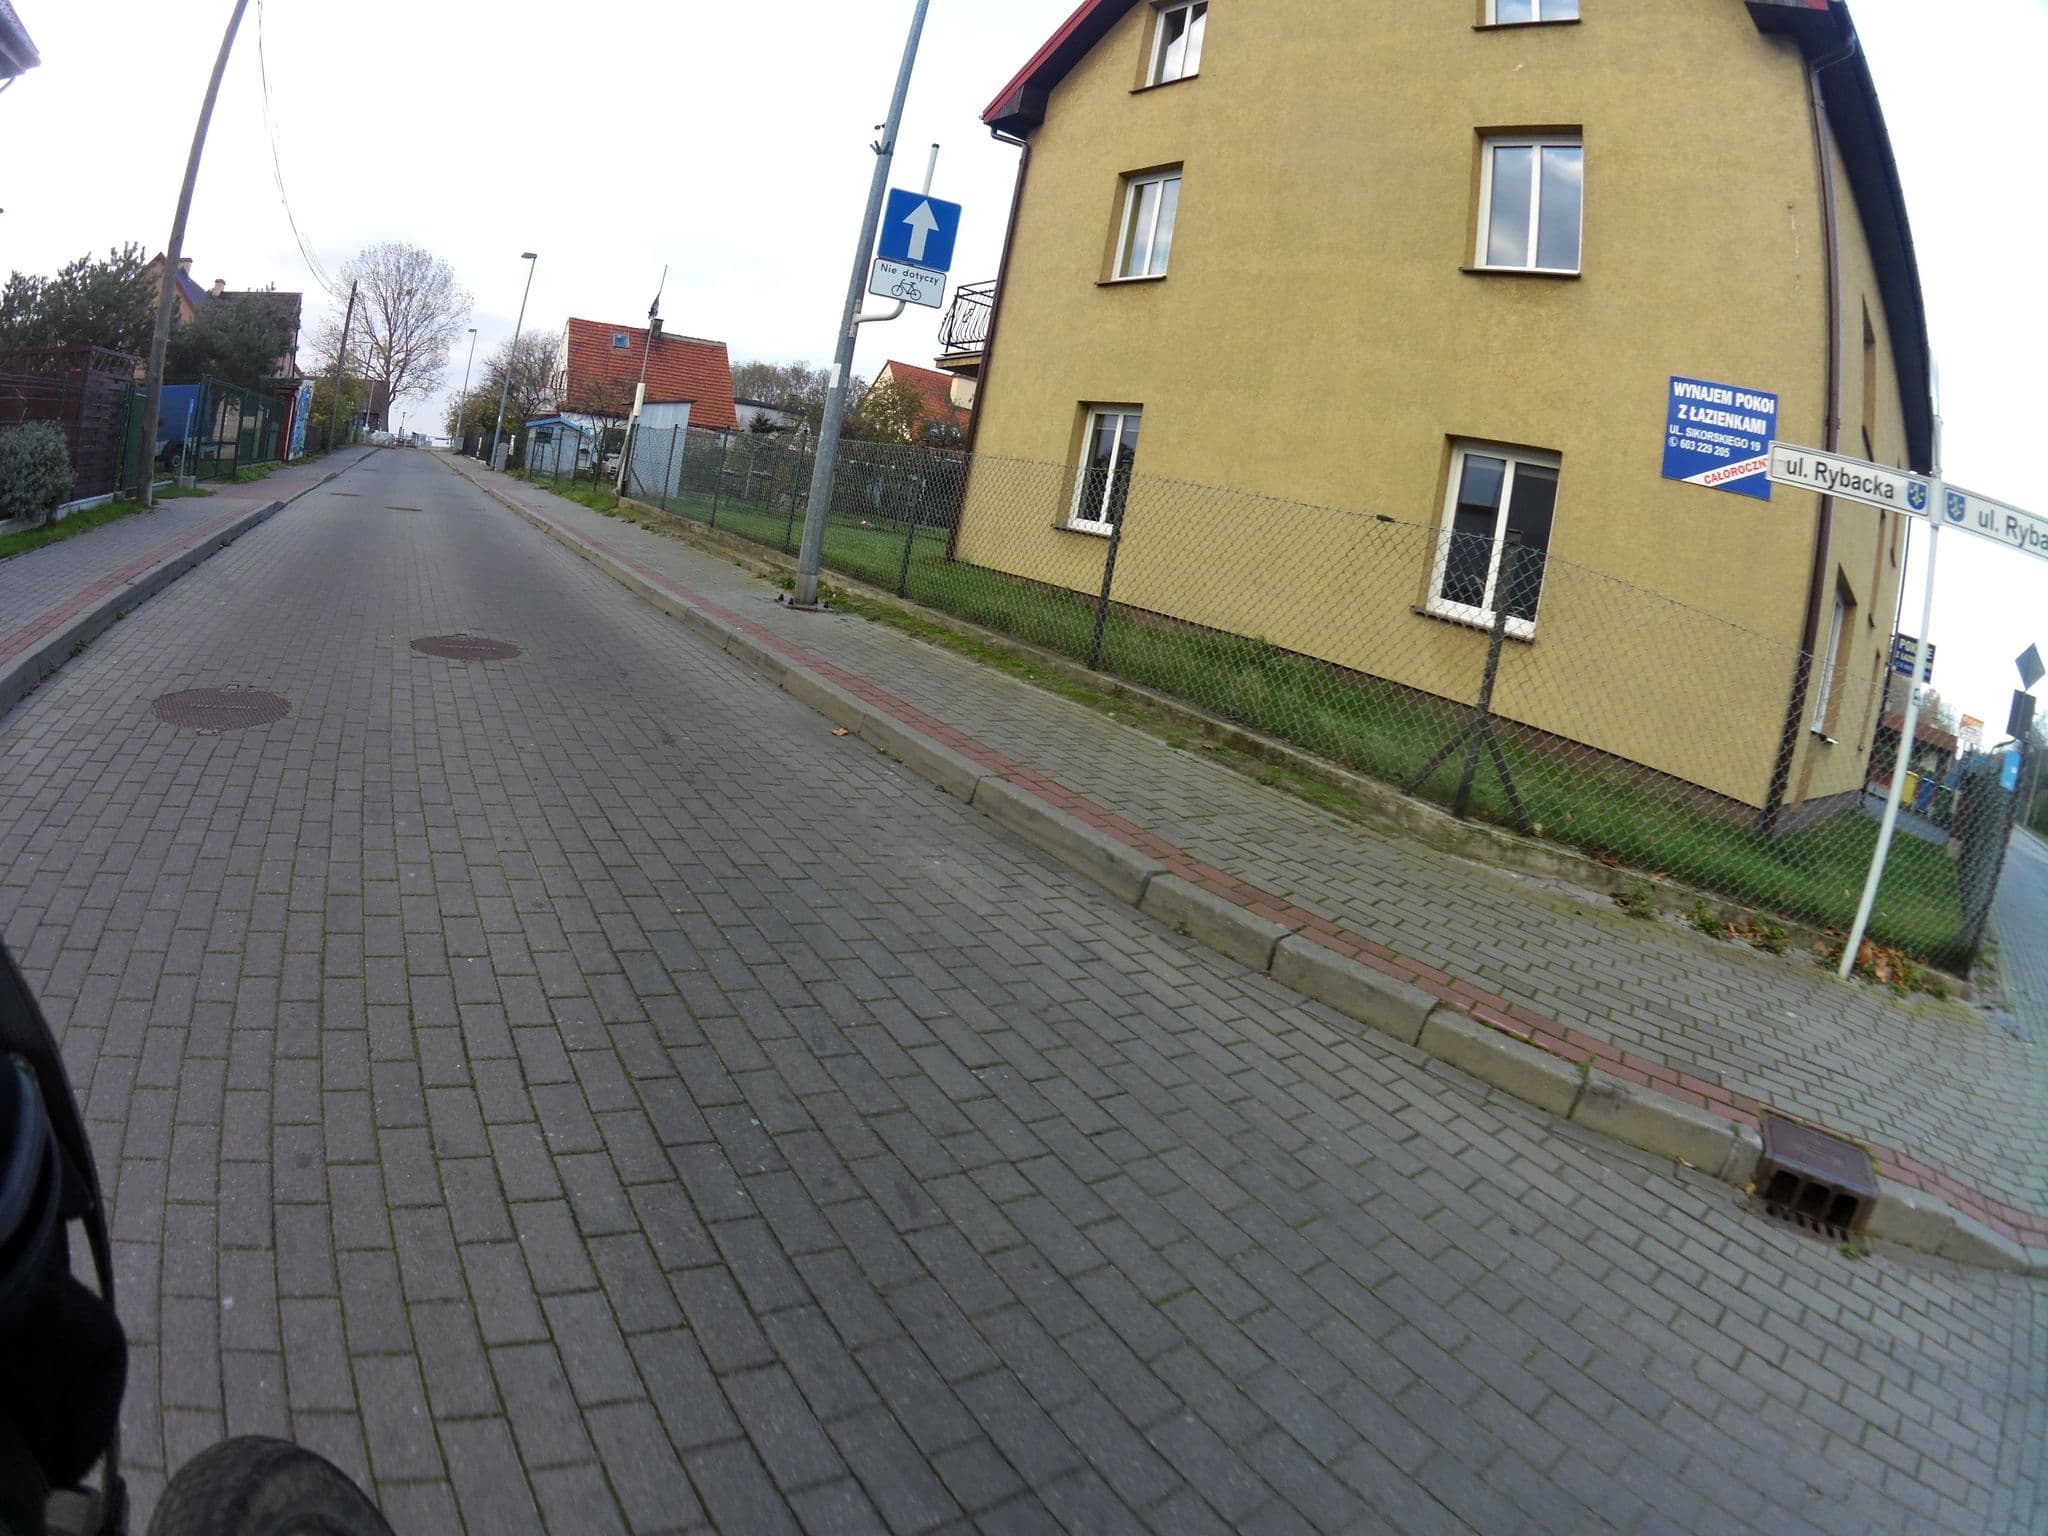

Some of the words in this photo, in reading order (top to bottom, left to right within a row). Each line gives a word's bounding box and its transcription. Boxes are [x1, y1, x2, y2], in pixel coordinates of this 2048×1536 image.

[881, 264, 897, 275] Nie
[903, 268, 939, 286] dotyczy
[1673, 381, 1732, 406] WYNAJEM
[1735, 392, 1775, 414] POKOI
[1677, 404, 1688, 419] Z
[1689, 406, 1766, 435] ŁAZIENKAMI
[1669, 424, 1684, 436] UL.
[1685, 427, 1748, 448] SIKORSKIEGO
[1750, 441, 1761, 451] 19
[1680, 439, 1695, 451] 603
[1714, 446, 1730, 458] 205
[1704, 457, 1768, 484] CAŁOROCZN
[1787, 457, 1808, 479] ul.
[1815, 461, 1895, 500] Rybacka
[1978, 509, 1999, 533] ul.
[2005, 515, 2048, 550] Ryba
